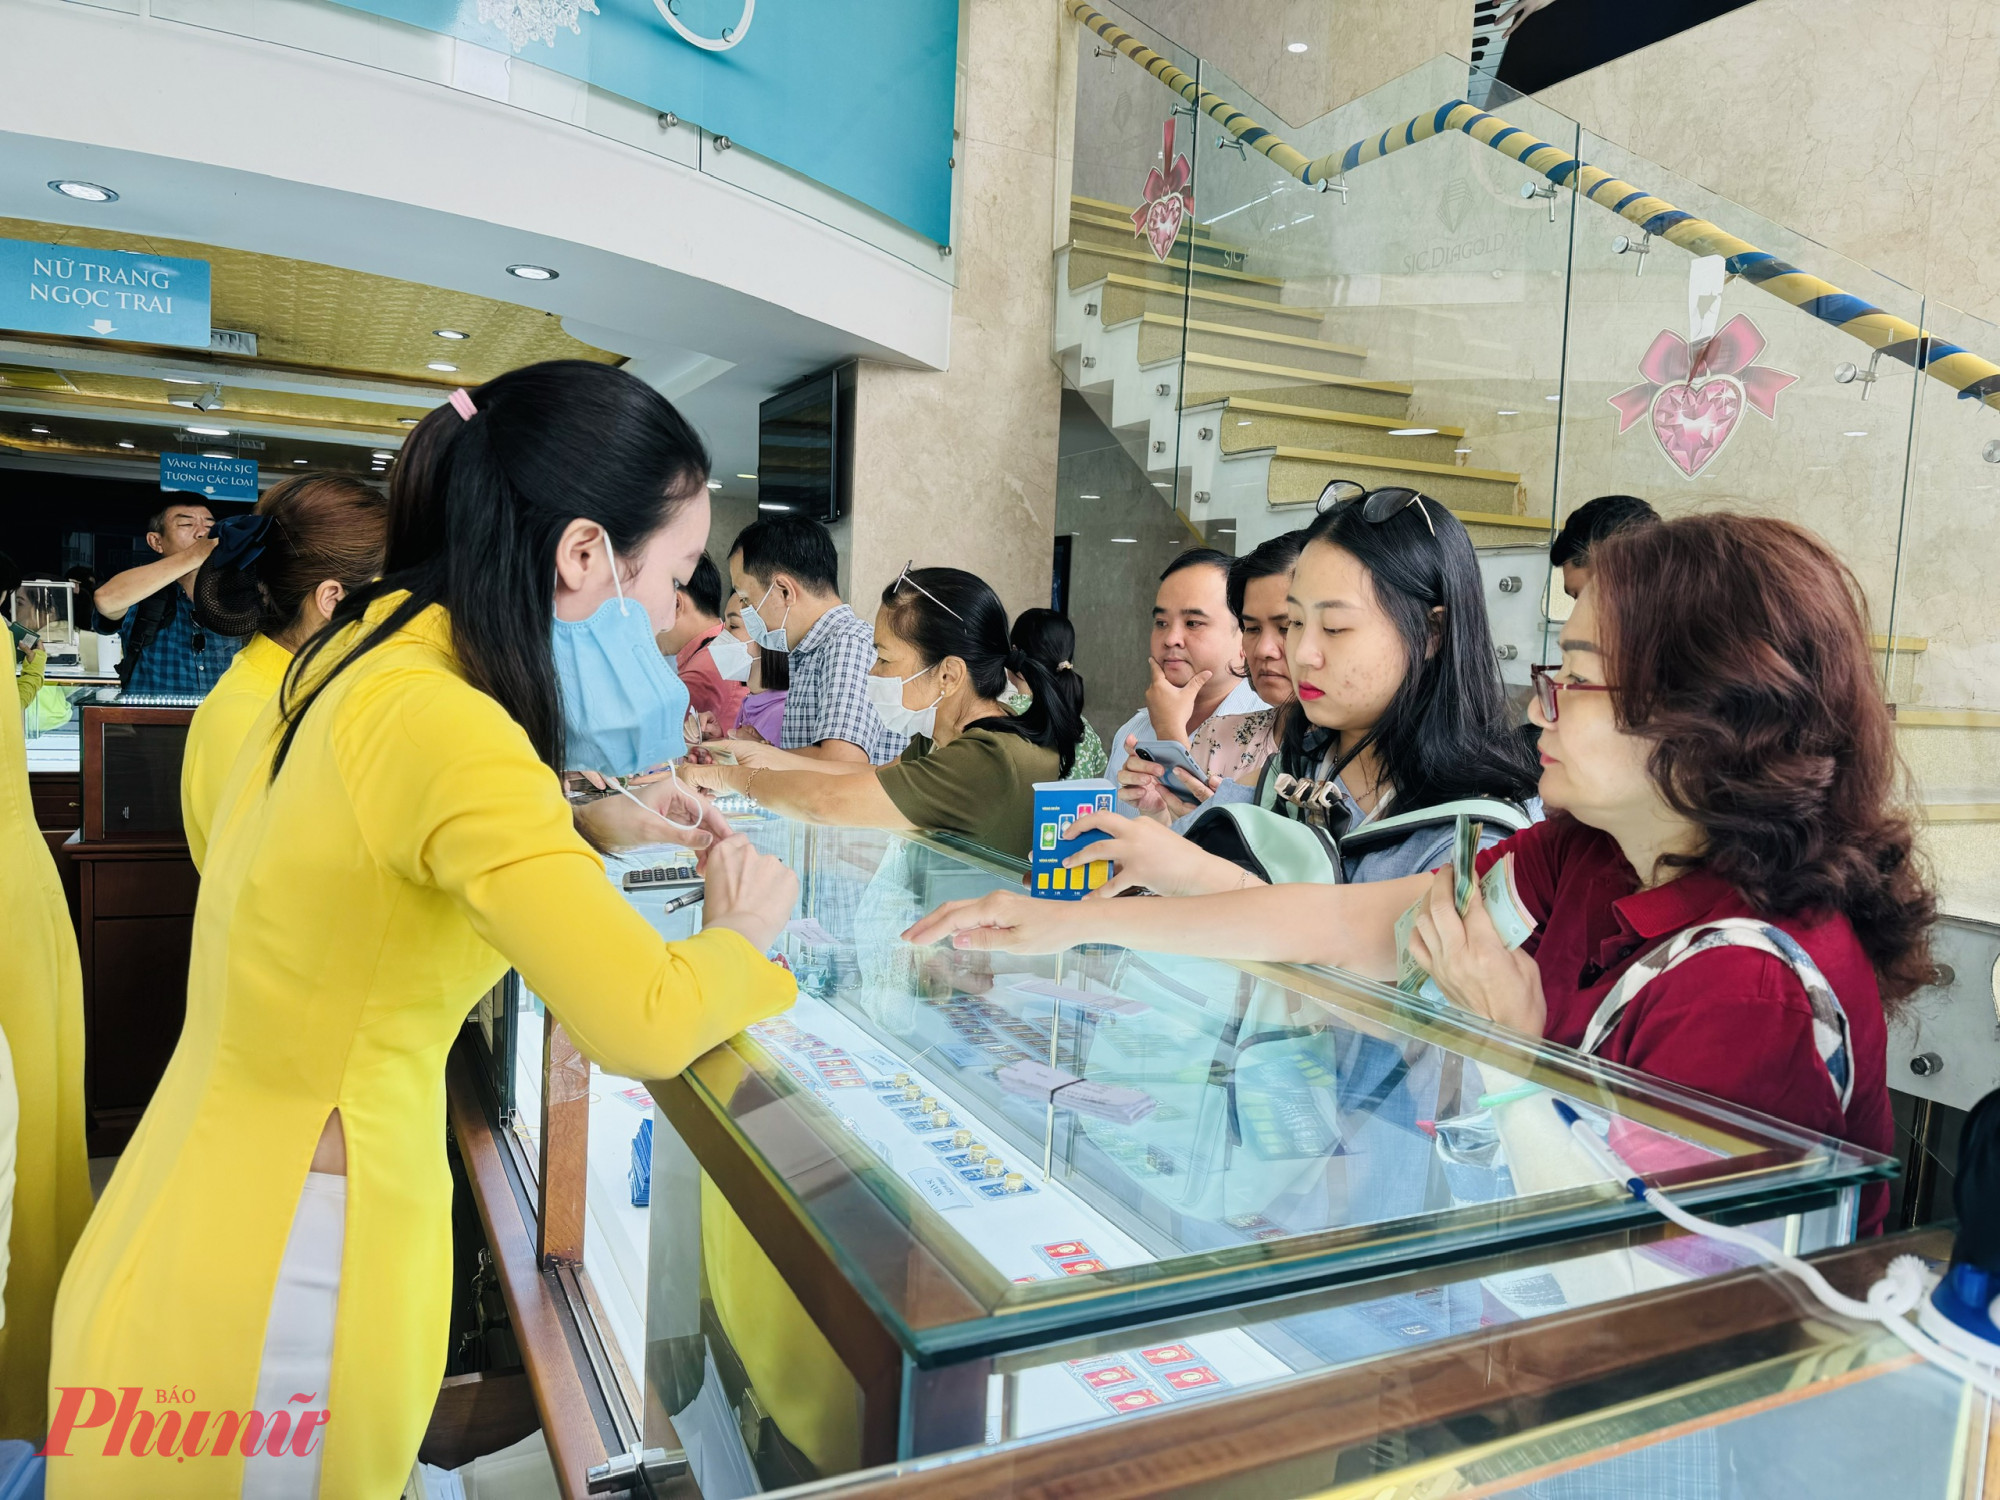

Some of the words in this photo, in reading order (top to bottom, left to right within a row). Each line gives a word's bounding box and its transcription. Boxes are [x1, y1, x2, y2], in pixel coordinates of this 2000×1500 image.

[1431, 233, 1505, 269] DIAGOLD
[33, 257, 75, 279] NỮ
[79, 263, 169, 289] TRANG
[30, 282, 109, 309] NGỌC
[115, 292, 173, 314] TRAI
[164, 471, 204, 483] TƯỢNG
[206, 474, 228, 485] CÁC
[231, 476, 253, 488] LOẠI
[167, 458, 197, 469] VÀNG
[234, 464, 253, 475] SJC
